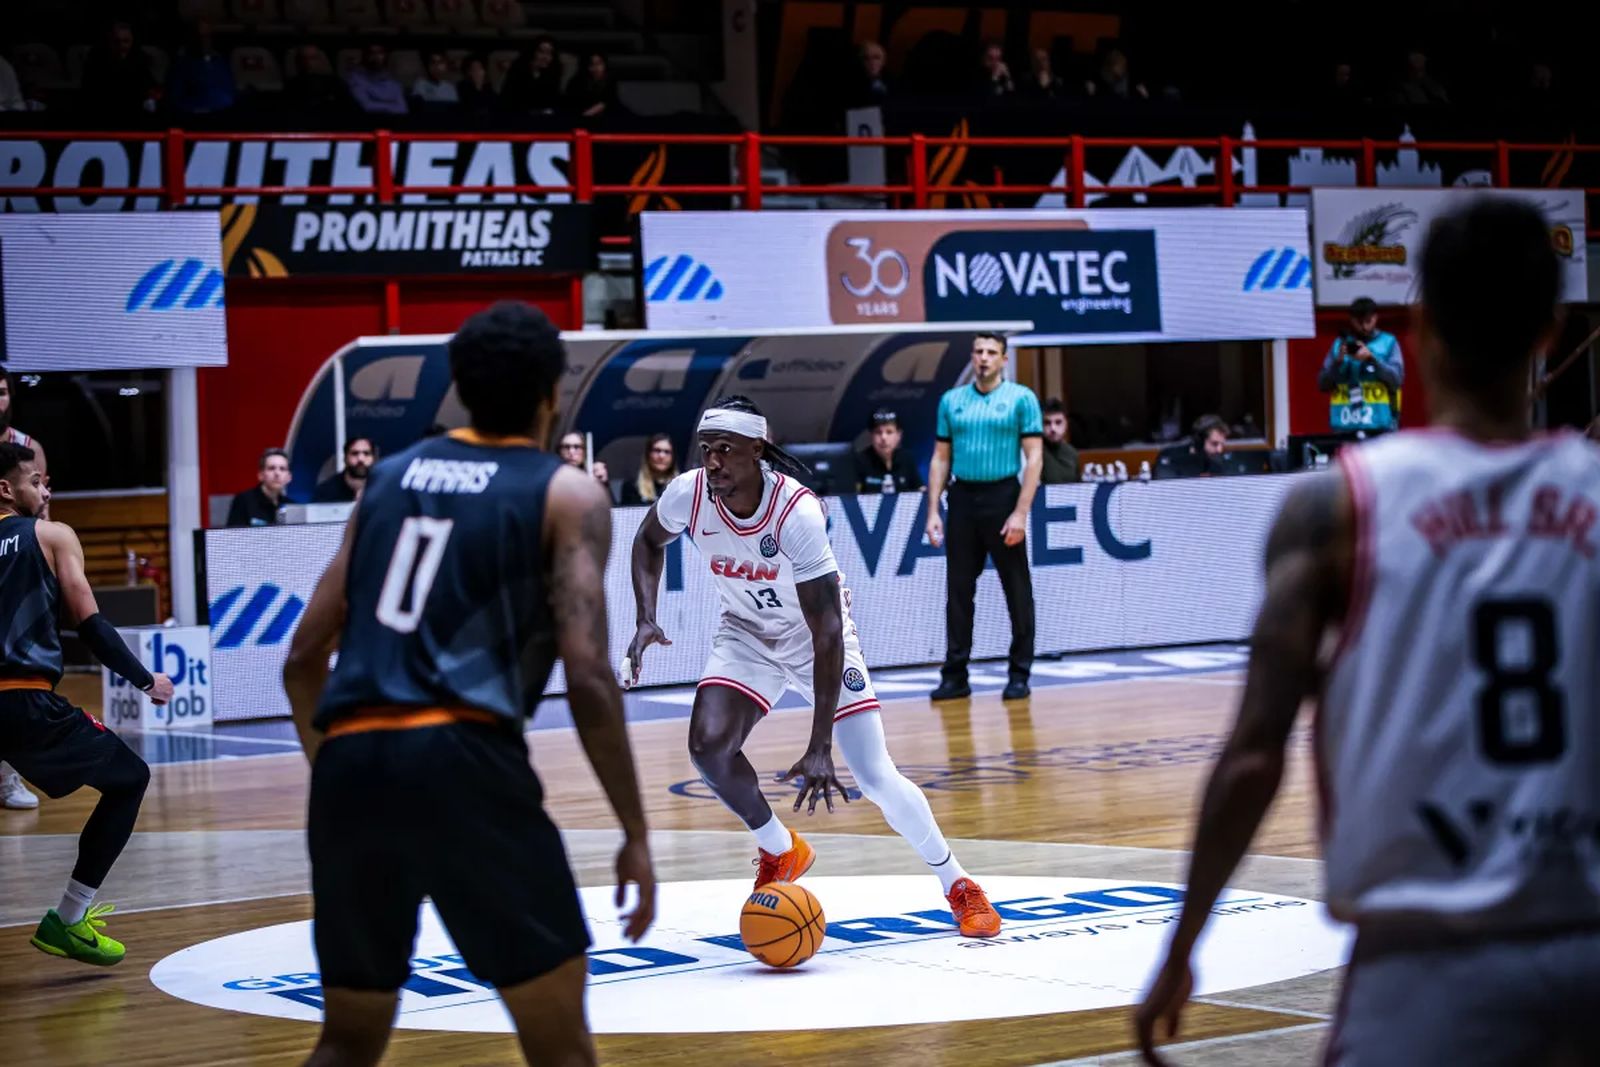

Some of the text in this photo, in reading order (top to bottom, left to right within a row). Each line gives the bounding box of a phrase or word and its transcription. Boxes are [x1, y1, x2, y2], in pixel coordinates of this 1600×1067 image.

[291, 209, 553, 252] PROMITHEAS
[461, 250, 520, 267] PATRAS
[841, 236, 910, 298] 30
[934, 250, 1131, 298] NOVATEC
[856, 301, 899, 316] YEARS
[1061, 296, 1132, 315] engineering
[375, 515, 455, 635] 0
[710, 553, 781, 582] ELAN
[744, 587, 783, 610] 13
[1471, 596, 1568, 765] 8
